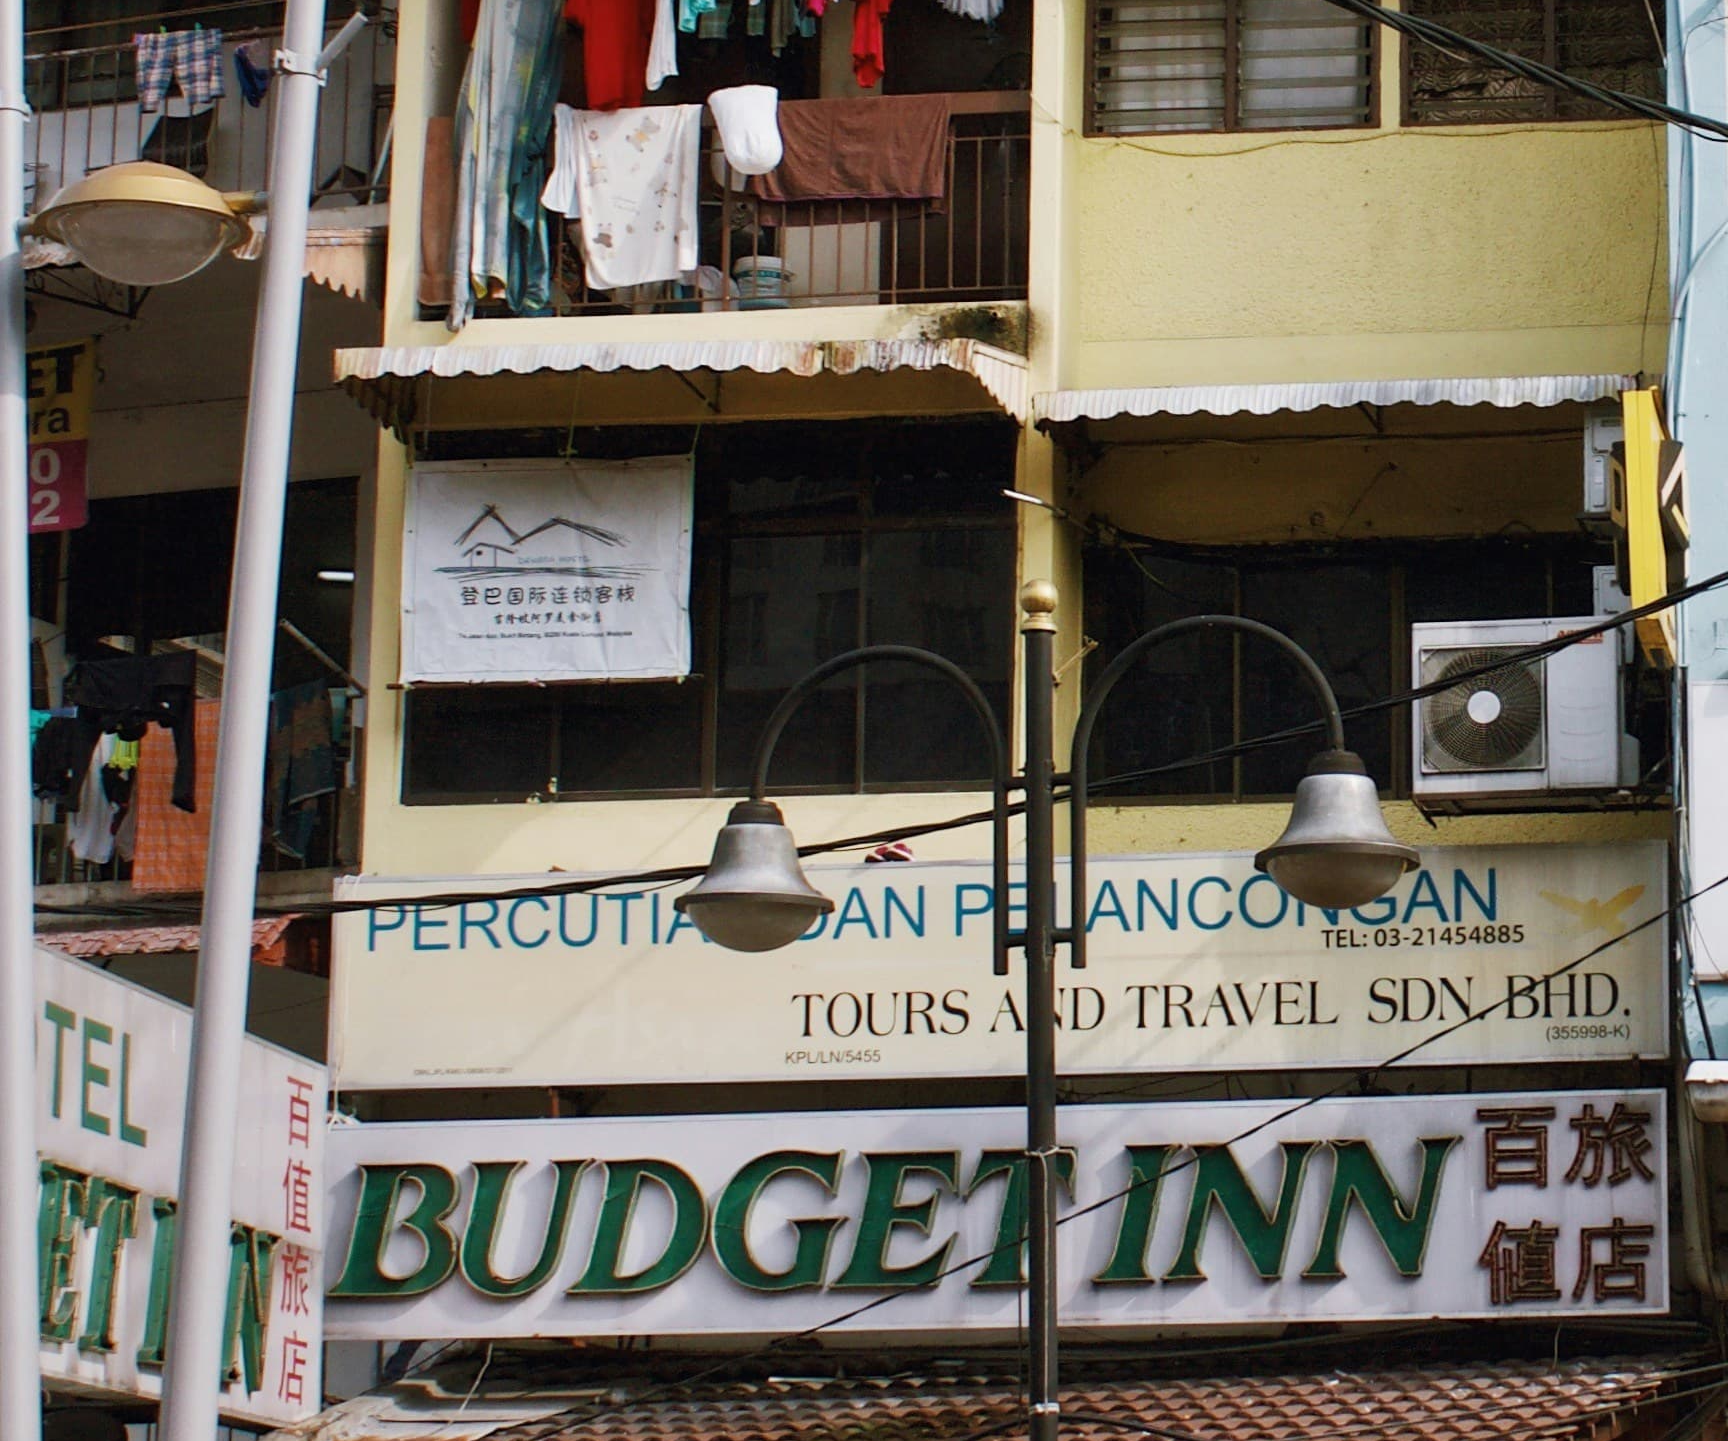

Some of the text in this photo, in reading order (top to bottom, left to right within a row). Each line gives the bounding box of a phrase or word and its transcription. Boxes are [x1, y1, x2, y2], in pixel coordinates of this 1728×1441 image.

[460, 585, 636, 606] 登巴国际连锁客栈
[1321, 924, 1525, 949] TEL: 03-21454885
[791, 988, 972, 1039] TOURS
[1124, 979, 1339, 1029] TRAVEL
[1505, 972, 1631, 1020] BHD.
[1545, 1023, 1631, 1042] (355998-K)
[785, 1049, 882, 1066] KPL/LN/5455
[326, 1134, 1465, 1297] BUDGET INN
